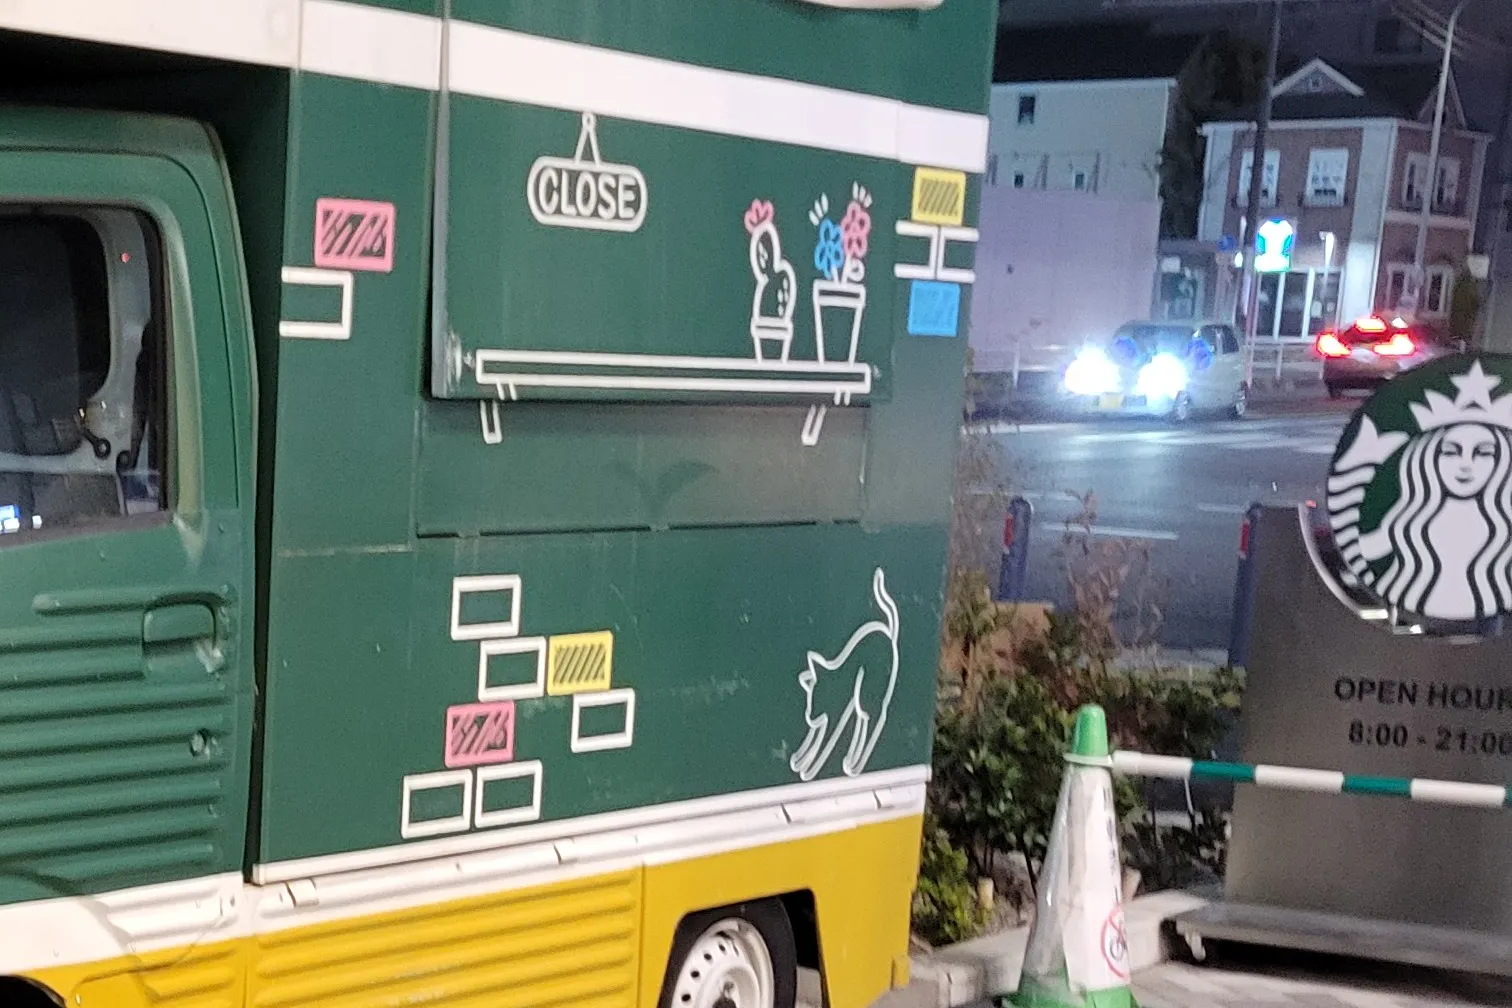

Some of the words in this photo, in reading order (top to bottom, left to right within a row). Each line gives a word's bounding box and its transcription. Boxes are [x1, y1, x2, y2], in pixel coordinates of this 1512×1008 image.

[538, 168, 637, 219] CLOSE
[1334, 675, 1417, 706] OPEN
[1348, 718, 1408, 748] 8:00
